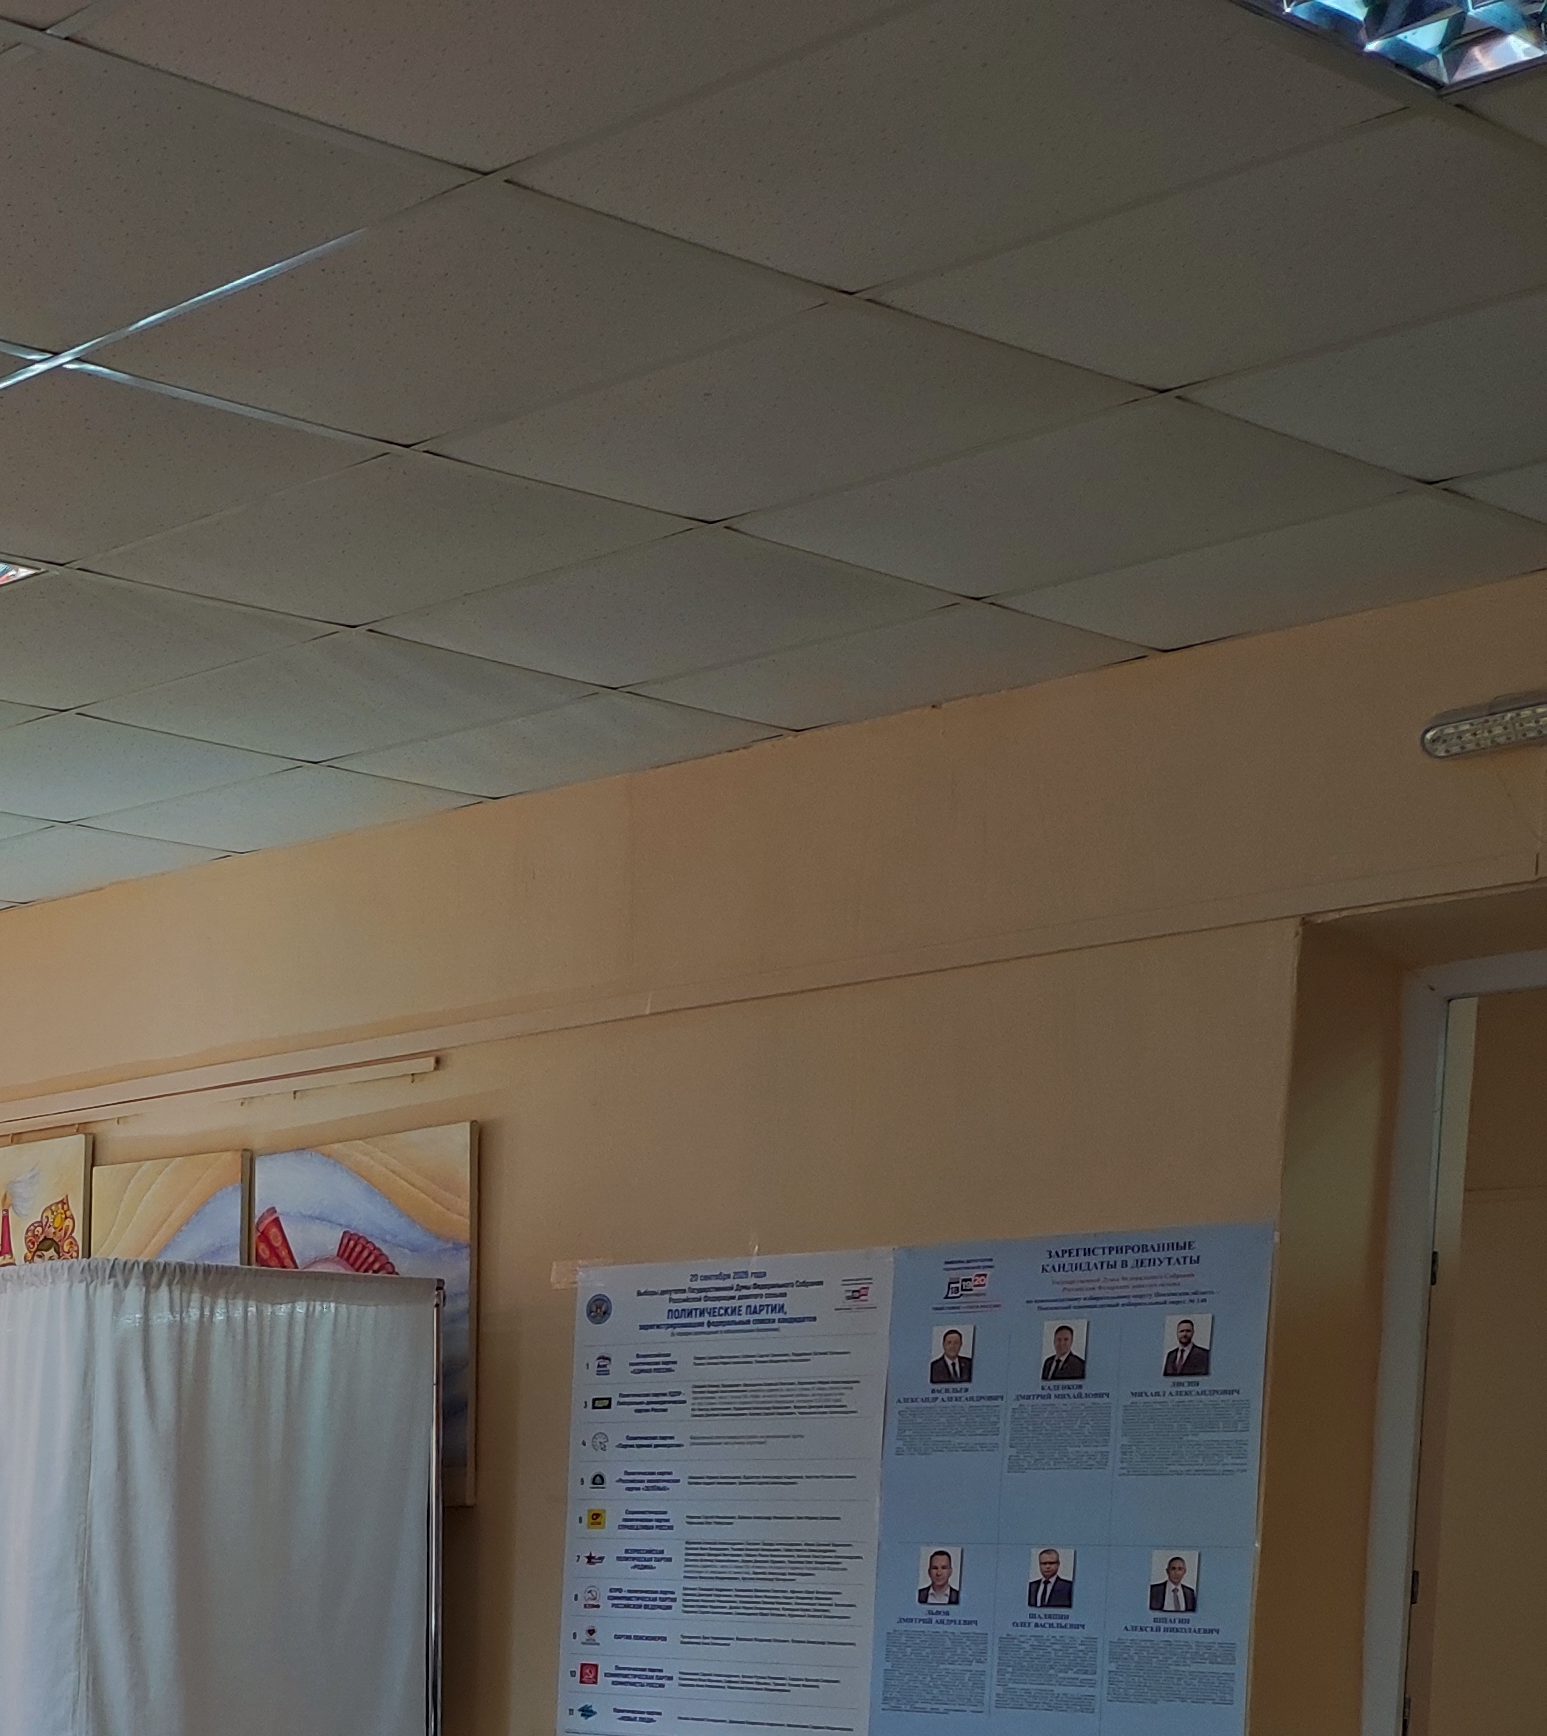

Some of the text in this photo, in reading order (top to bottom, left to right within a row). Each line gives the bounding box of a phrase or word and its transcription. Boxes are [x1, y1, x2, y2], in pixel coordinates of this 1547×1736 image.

[1046, 1241, 1195, 1259] ЗАРЕГИСТРИРОВАННЫЕ
[1041, 1255, 1201, 1273] КАНДИДАТЫ В ДЕПУТАТЫ
[973, 1276, 986, 1284] 20
[667, 1303, 787, 1319] ПОЛИТИЧЕСКИЕ ПАРТИИ,
